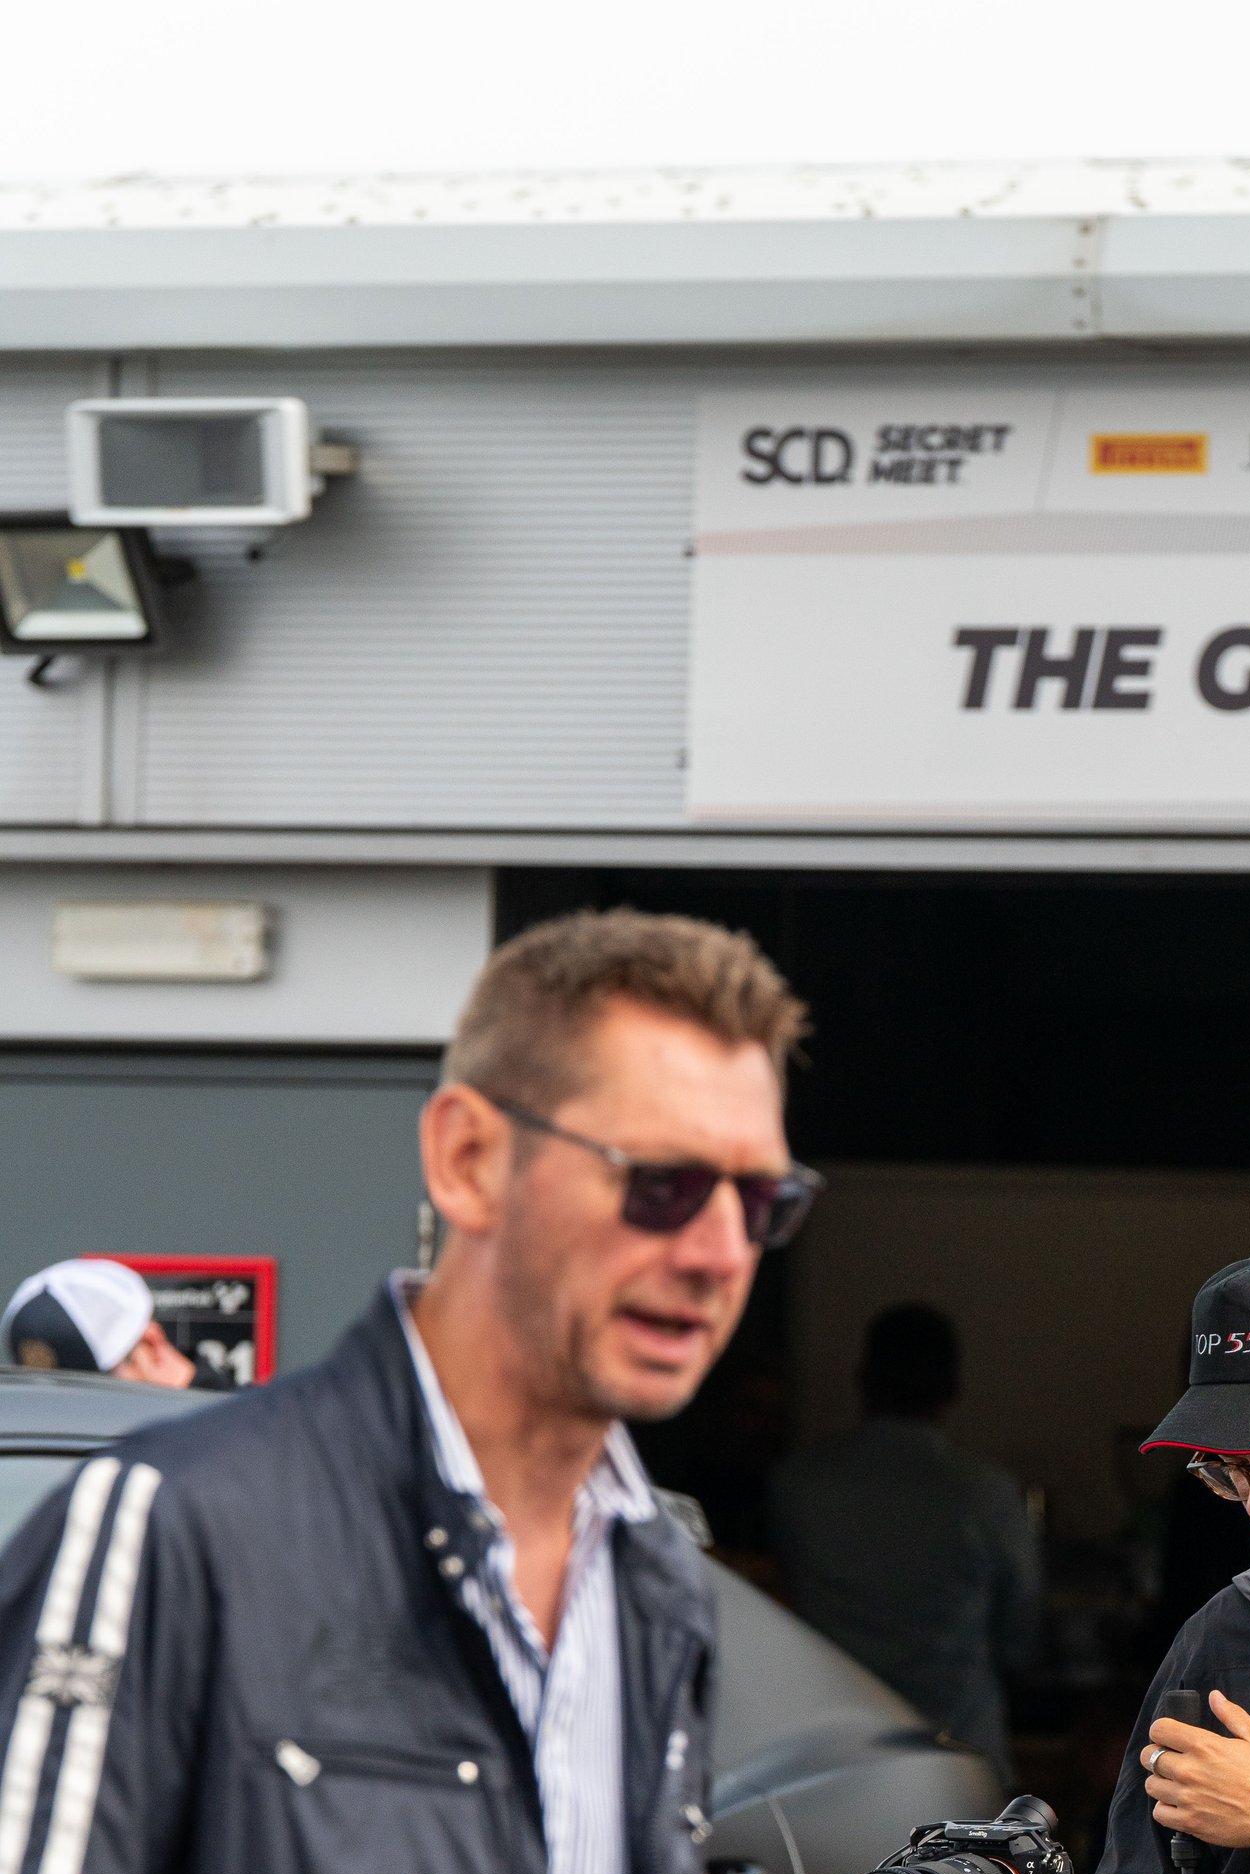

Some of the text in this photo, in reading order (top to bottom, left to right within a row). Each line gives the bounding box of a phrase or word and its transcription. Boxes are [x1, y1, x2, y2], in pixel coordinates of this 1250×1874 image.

[743, 426, 854, 485] SCD
[875, 424, 1011, 453] SECRET
[868, 457, 966, 485] MEET
[953, 626, 1165, 712] THE
